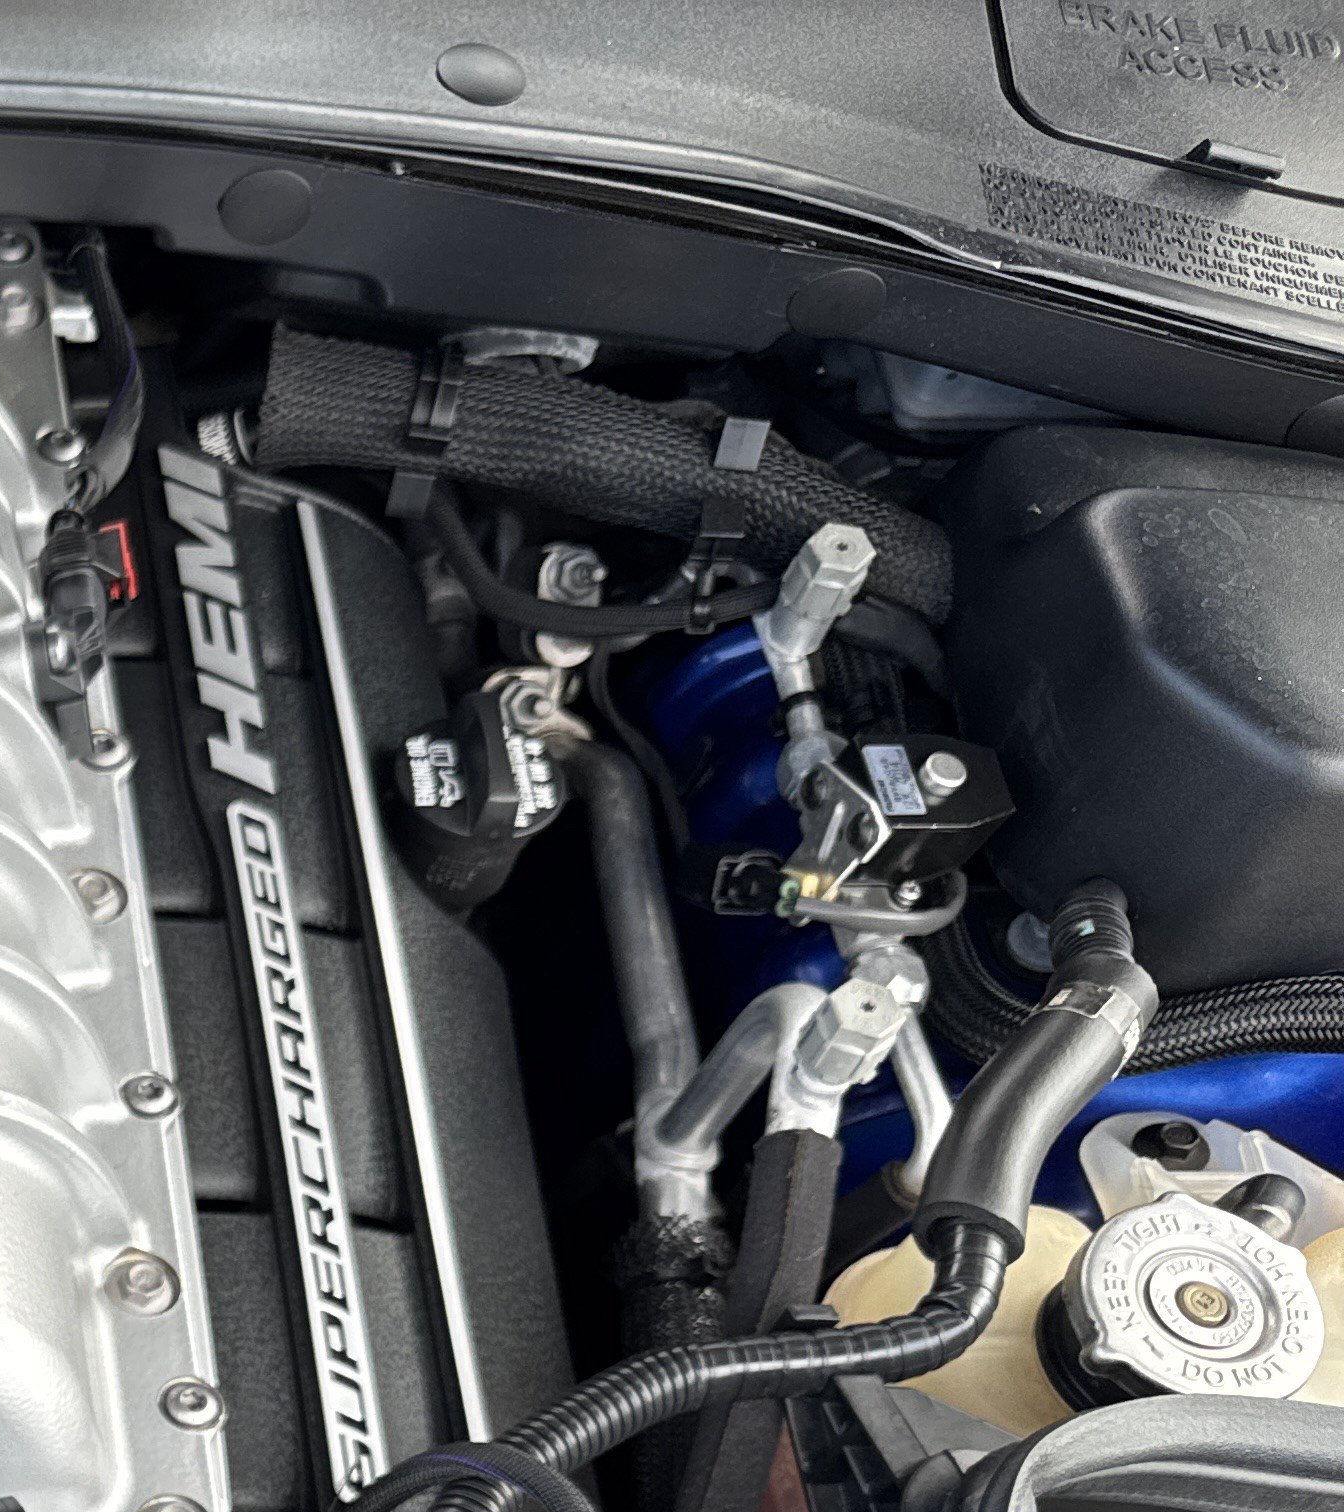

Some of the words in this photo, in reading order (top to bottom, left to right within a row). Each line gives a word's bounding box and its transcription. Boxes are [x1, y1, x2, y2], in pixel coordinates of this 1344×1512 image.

[1057, 0, 1205, 45] BRAKE
[1213, 22, 1342, 61] FLUID
[1117, 44, 1288, 92] ACCESS
[1219, 222, 1285, 247] BEFORE
[1237, 252, 1319, 281] BOUCHON
[157, 446, 277, 795] HEMI
[409, 757, 439, 808] ENGINE
[236, 812, 376, 1488] SUPERCHARGED
[1112, 1212, 1185, 1254] TIGHT
[1103, 1259, 1141, 1332] KEEP
[1181, 1358, 1224, 1388] DO
[1232, 1356, 1287, 1389] NOT
